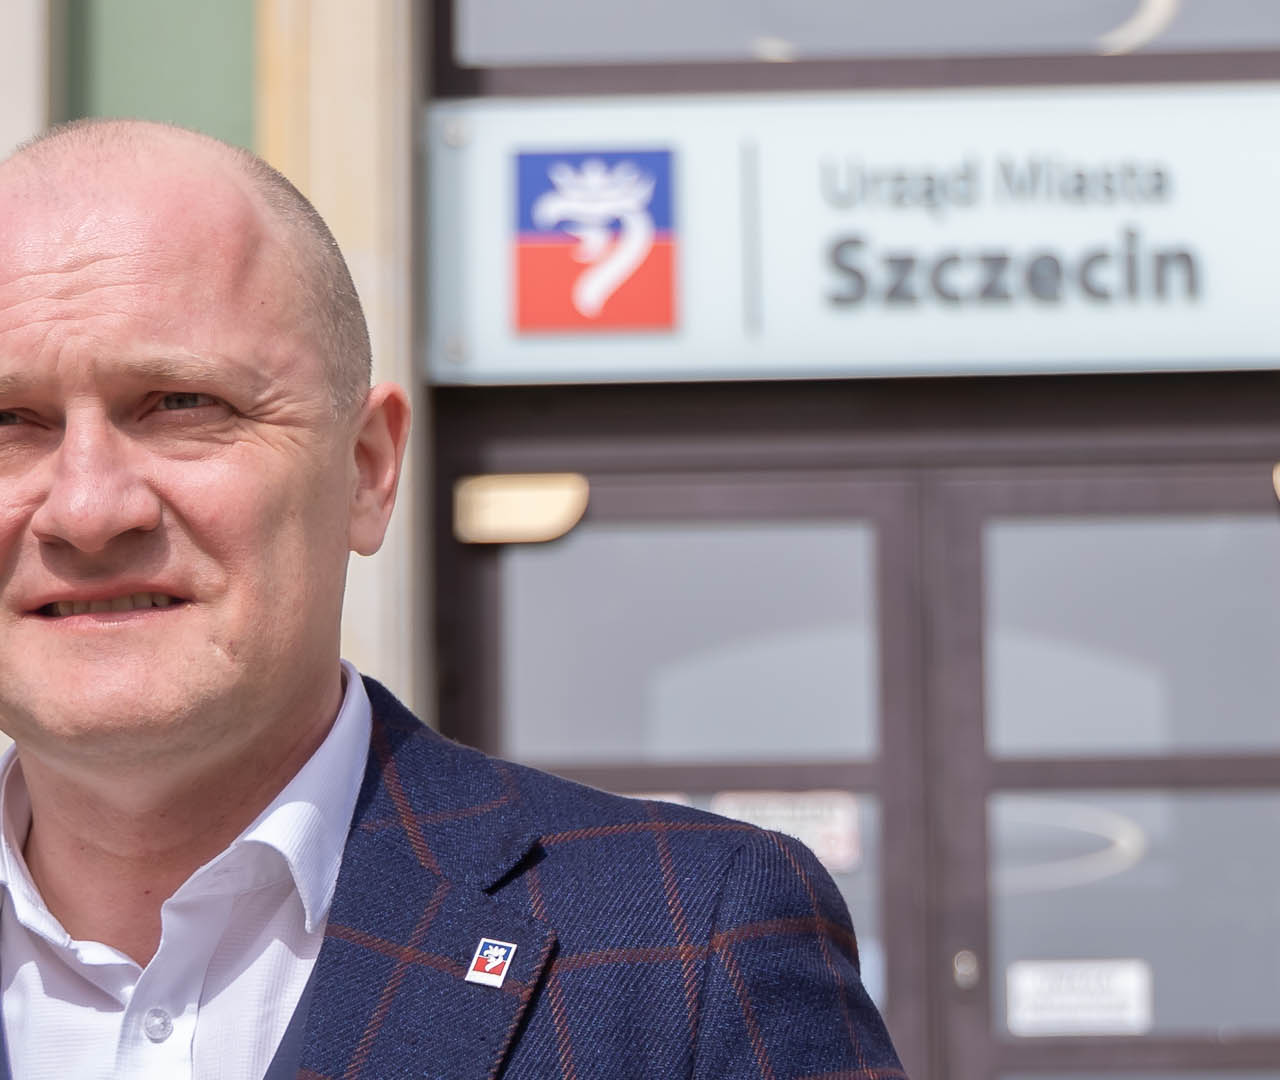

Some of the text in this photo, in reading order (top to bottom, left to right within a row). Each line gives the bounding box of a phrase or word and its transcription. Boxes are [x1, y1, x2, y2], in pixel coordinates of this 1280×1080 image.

[820, 153, 1172, 215] Urząd Miasta
[823, 226, 1205, 308] Szczecin
